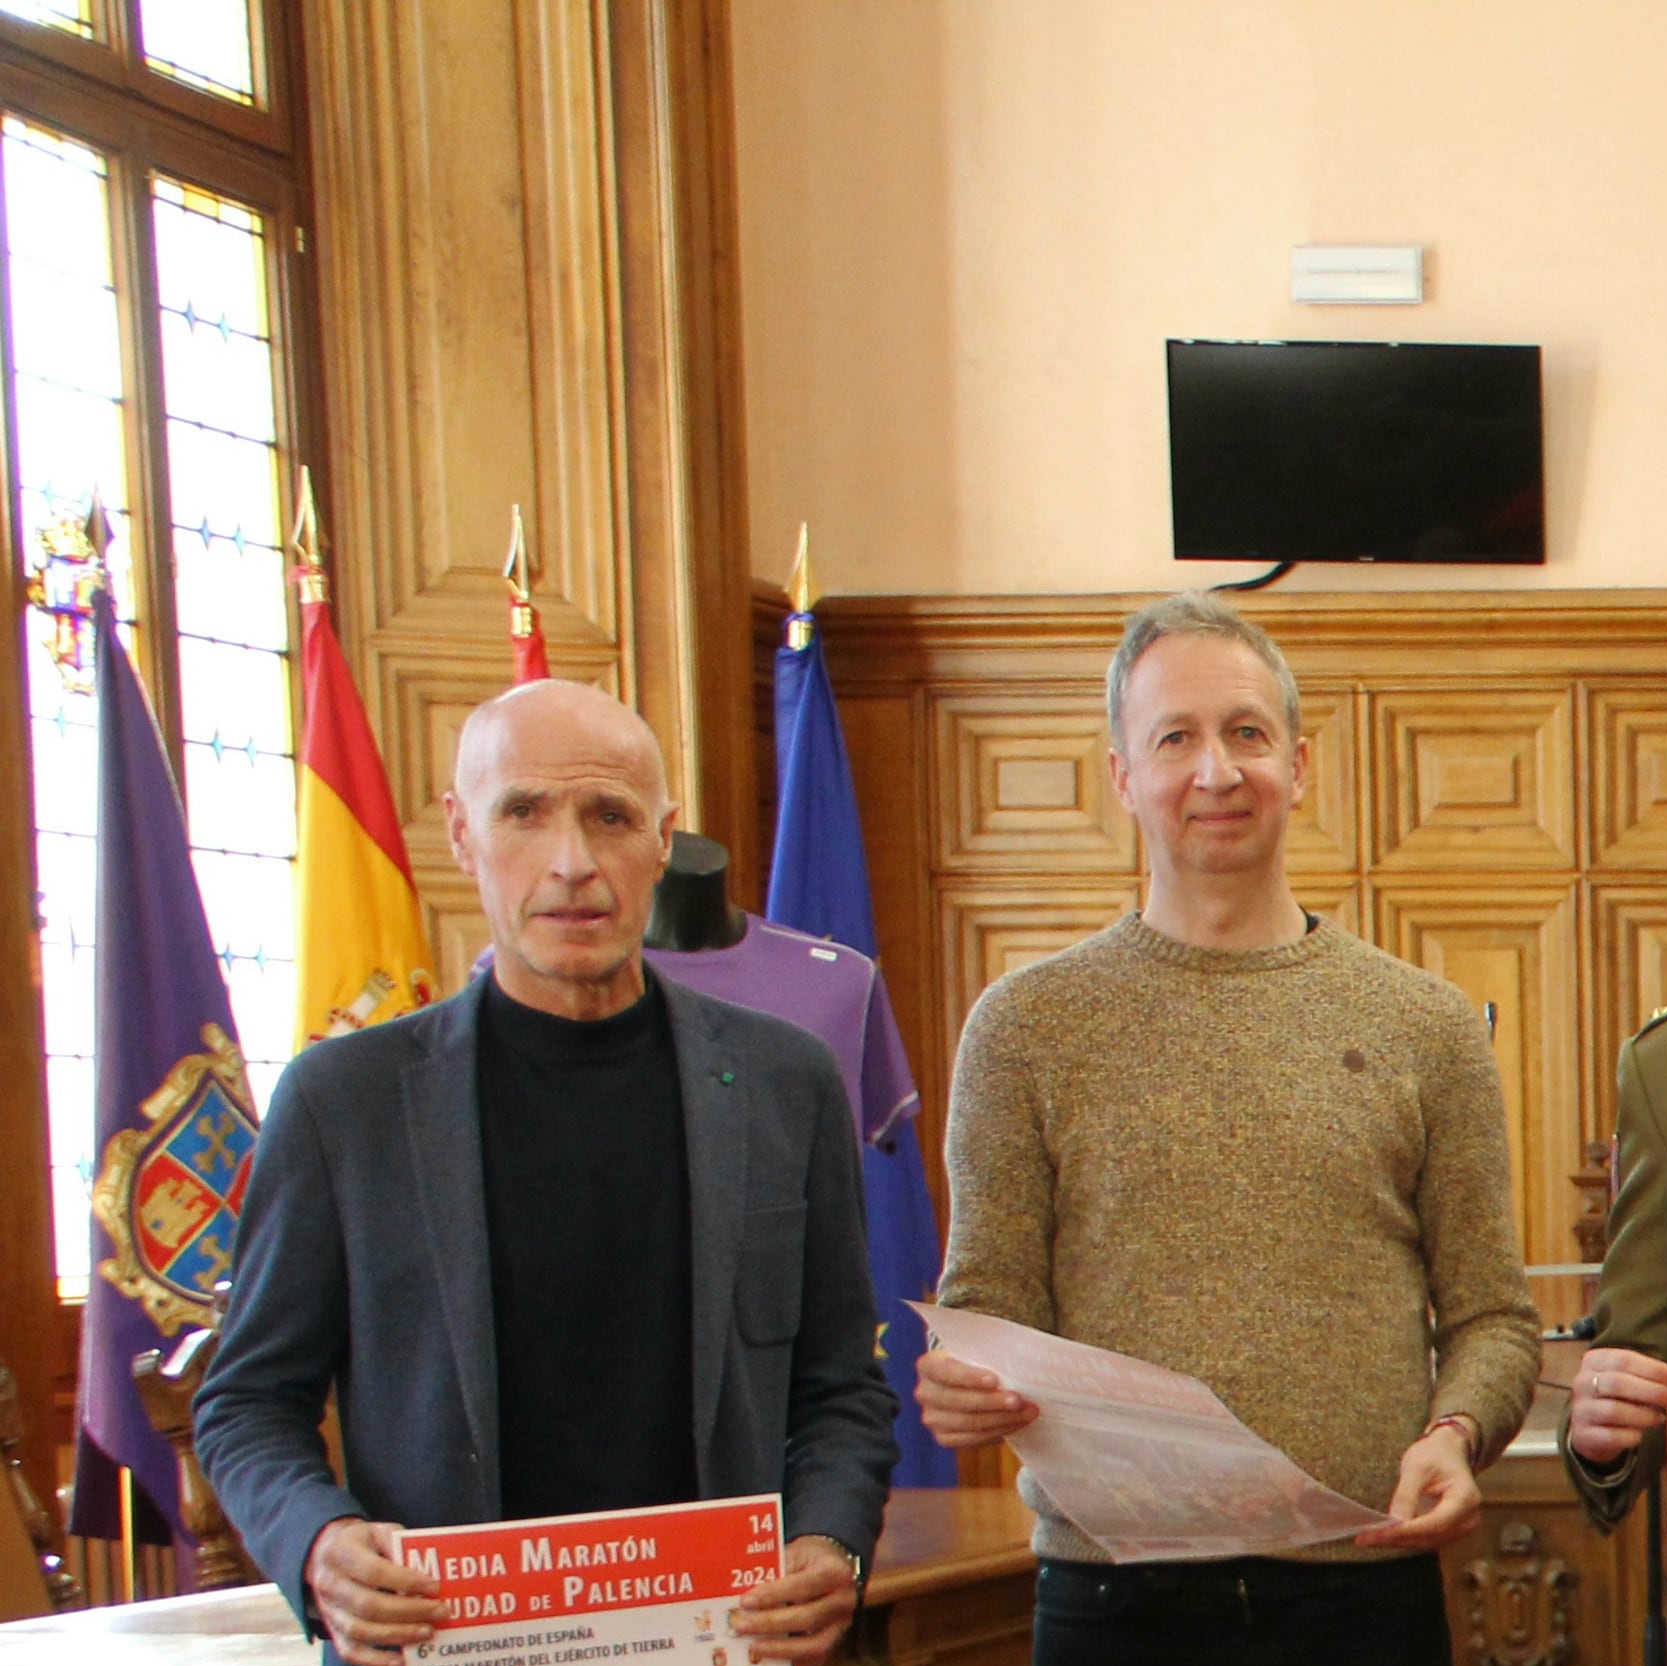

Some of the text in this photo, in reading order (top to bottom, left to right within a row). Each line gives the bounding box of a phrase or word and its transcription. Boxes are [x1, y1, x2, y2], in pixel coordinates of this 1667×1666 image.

[750, 1513, 773, 1534] 14
[408, 1535, 656, 1582] MEDIA MARATÓN
[746, 1539, 774, 1554] abril
[731, 1565, 776, 1588] 2024
[449, 1571, 693, 1621] UDAD DE PALENCIA
[439, 1636, 524, 1657] CAMPEONATO
[527, 1633, 542, 1646] DE
[546, 1627, 594, 1644] ESPAÑA
[528, 1652, 550, 1666] DEL
[554, 1644, 611, 1663] EJÉRCITO
[613, 1643, 628, 1656] DE
[632, 1637, 674, 1653] TIERRA
